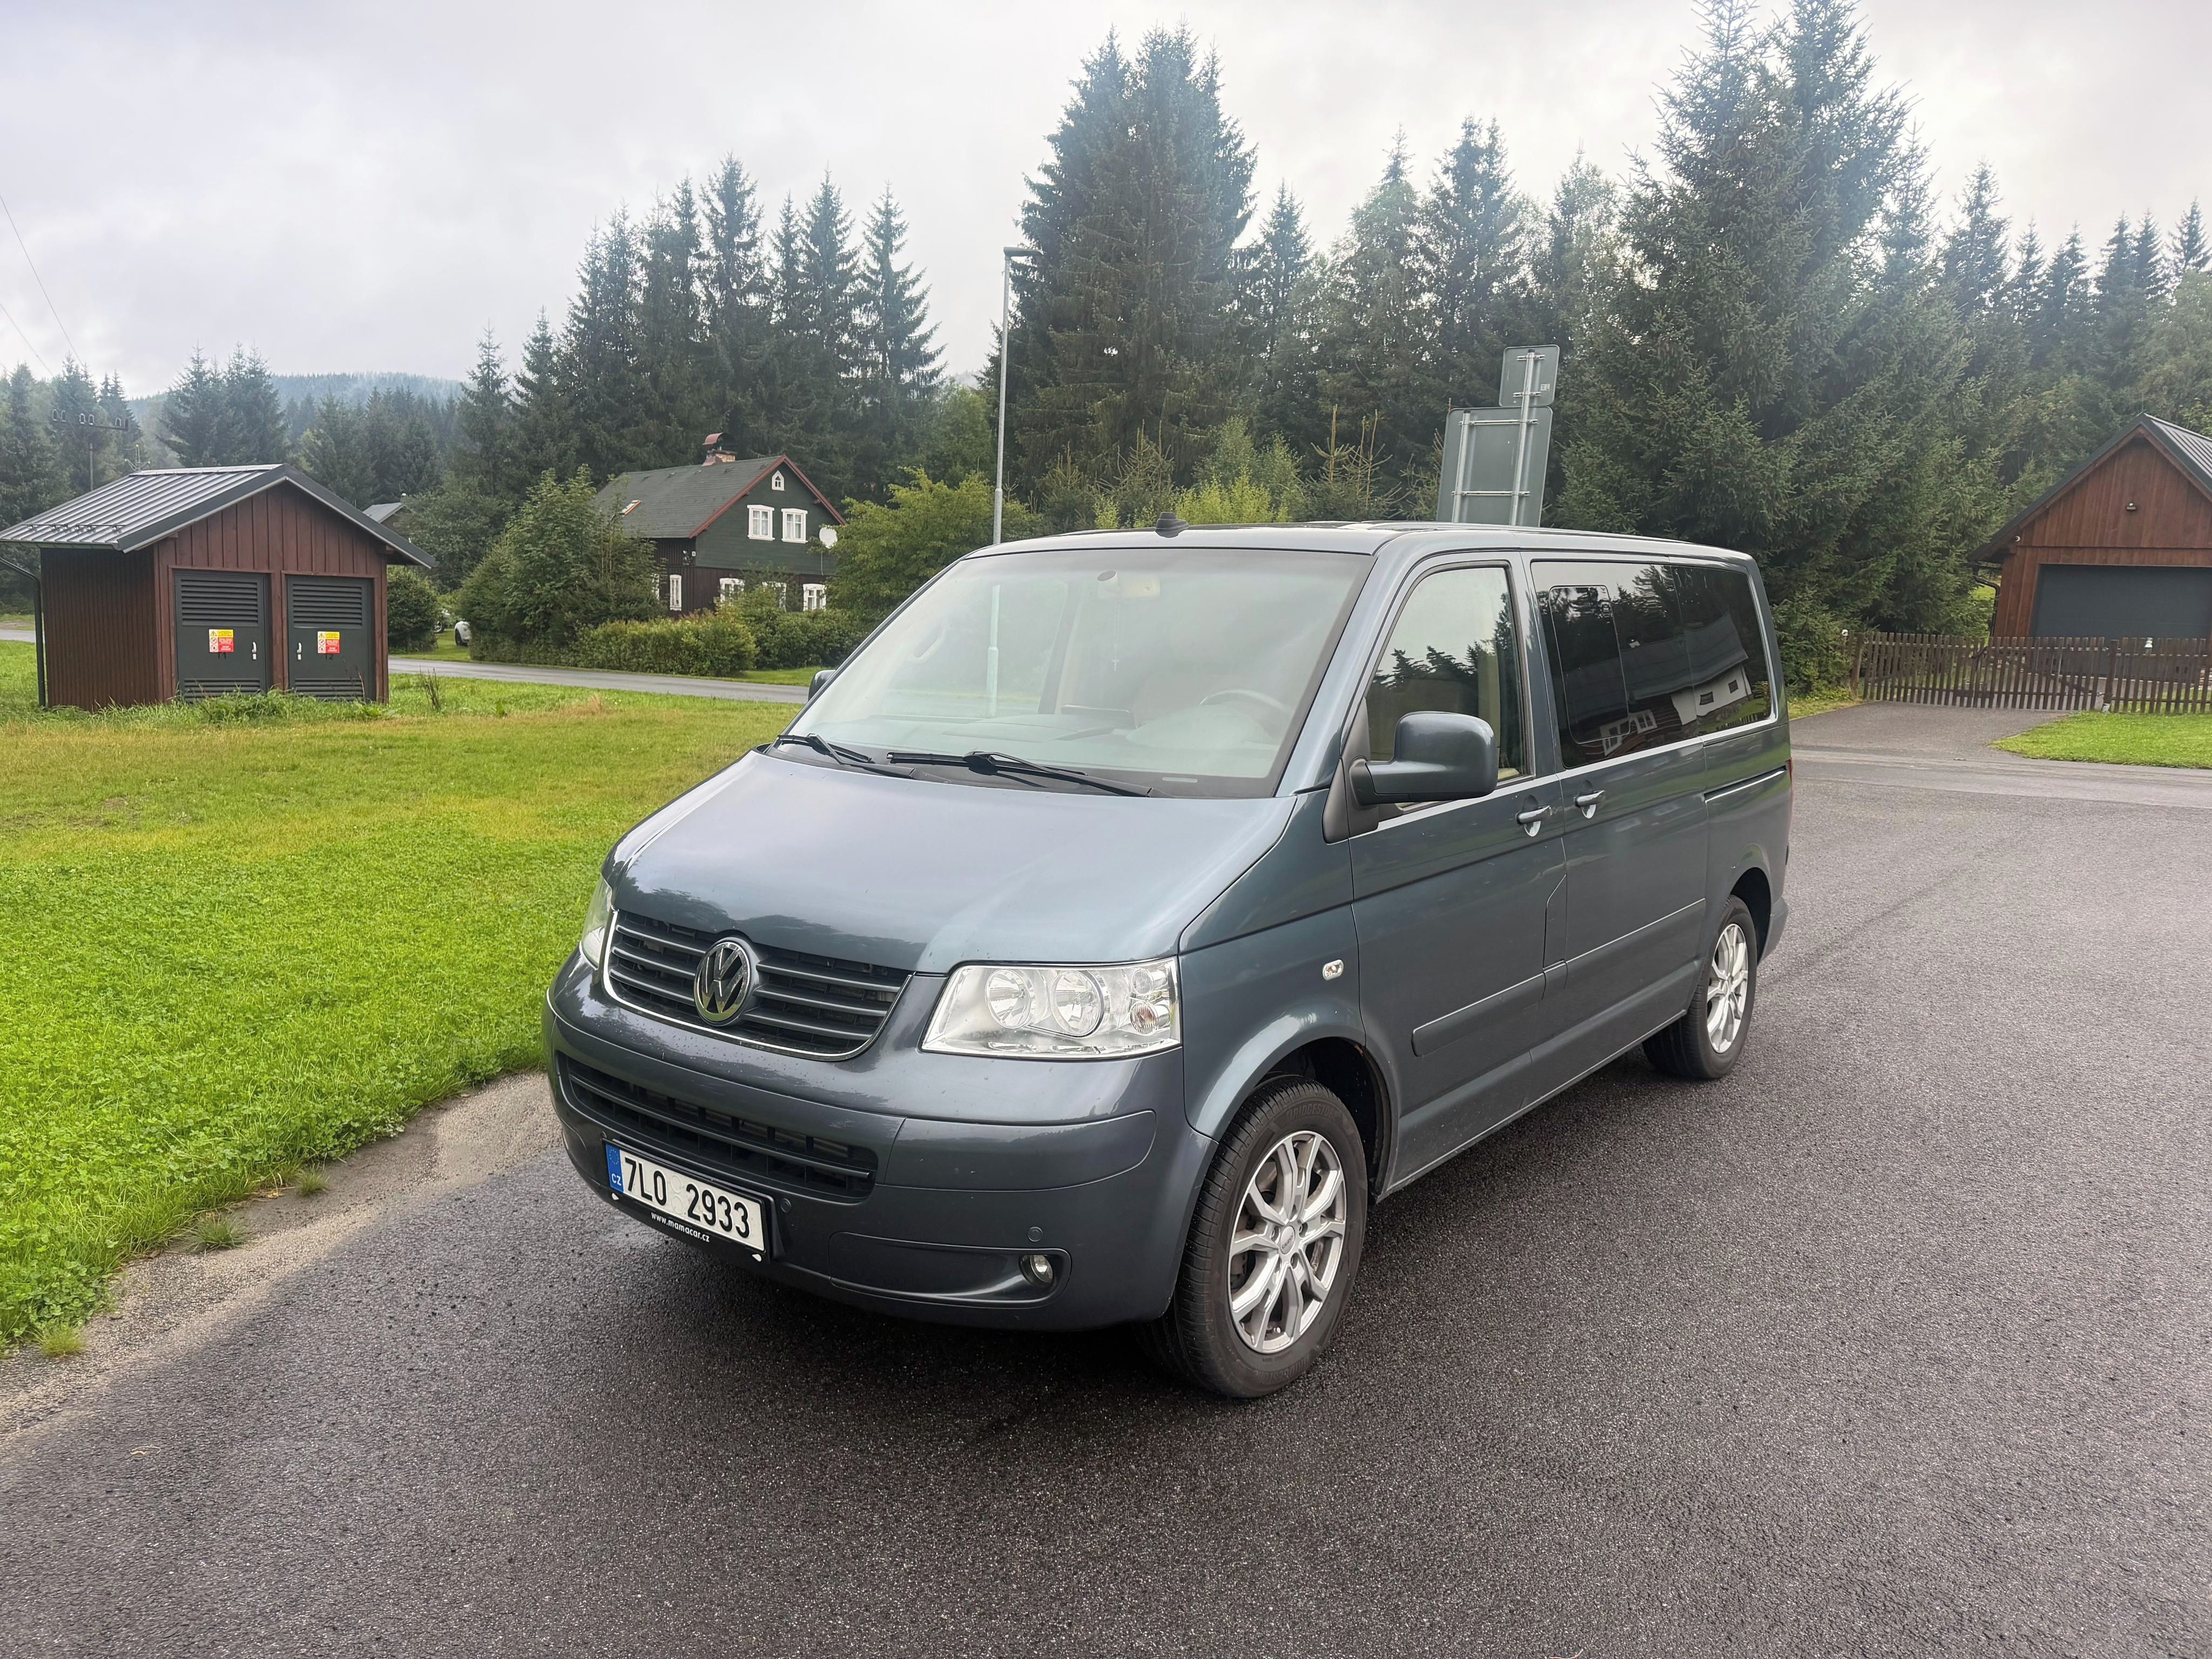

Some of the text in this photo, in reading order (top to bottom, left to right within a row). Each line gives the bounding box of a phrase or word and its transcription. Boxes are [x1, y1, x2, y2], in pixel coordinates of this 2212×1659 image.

[1286, 1103, 1338, 1123] BRIDGESTONE
[611, 1173, 622, 1186] CZ
[686, 1183, 750, 1238] 2933
[651, 1212, 710, 1243] www.mamacar.cz
